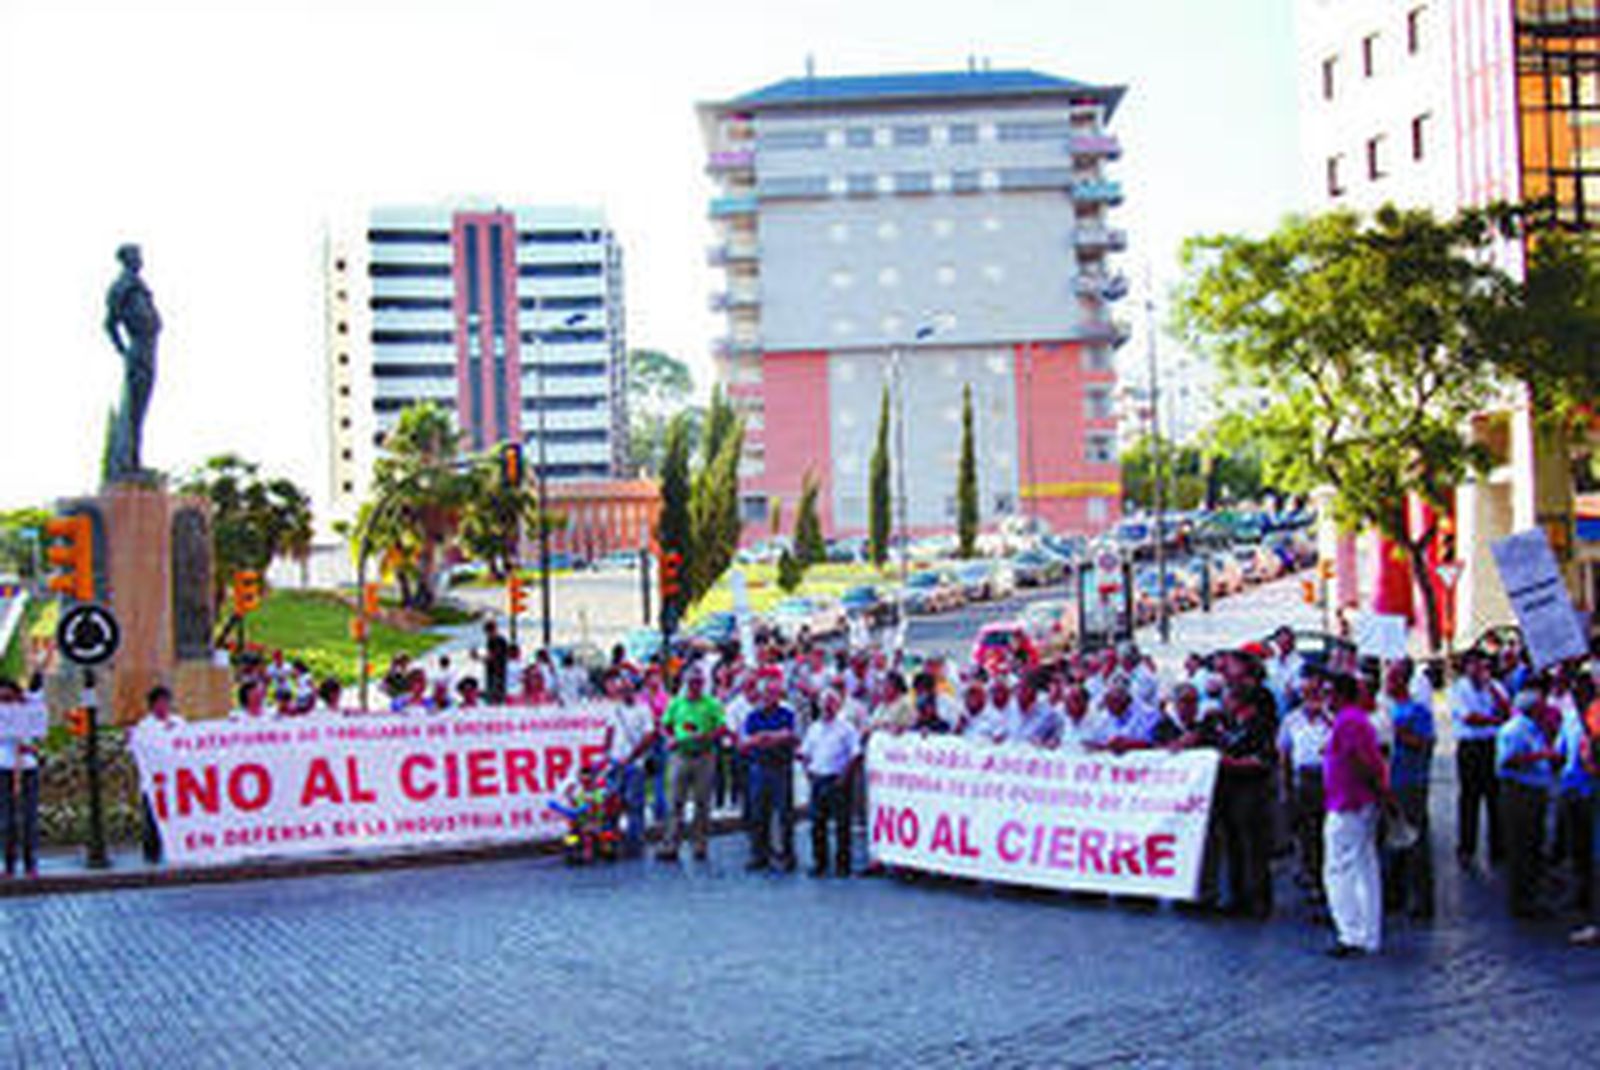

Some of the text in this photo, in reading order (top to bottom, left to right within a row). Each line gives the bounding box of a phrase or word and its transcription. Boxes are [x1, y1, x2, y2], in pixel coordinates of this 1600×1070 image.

[301, 755, 377, 806] AL
[184, 830, 216, 851] EN
[223, 820, 325, 849] DEFENSA
[872, 804, 1176, 877] NO AL CIERRE
